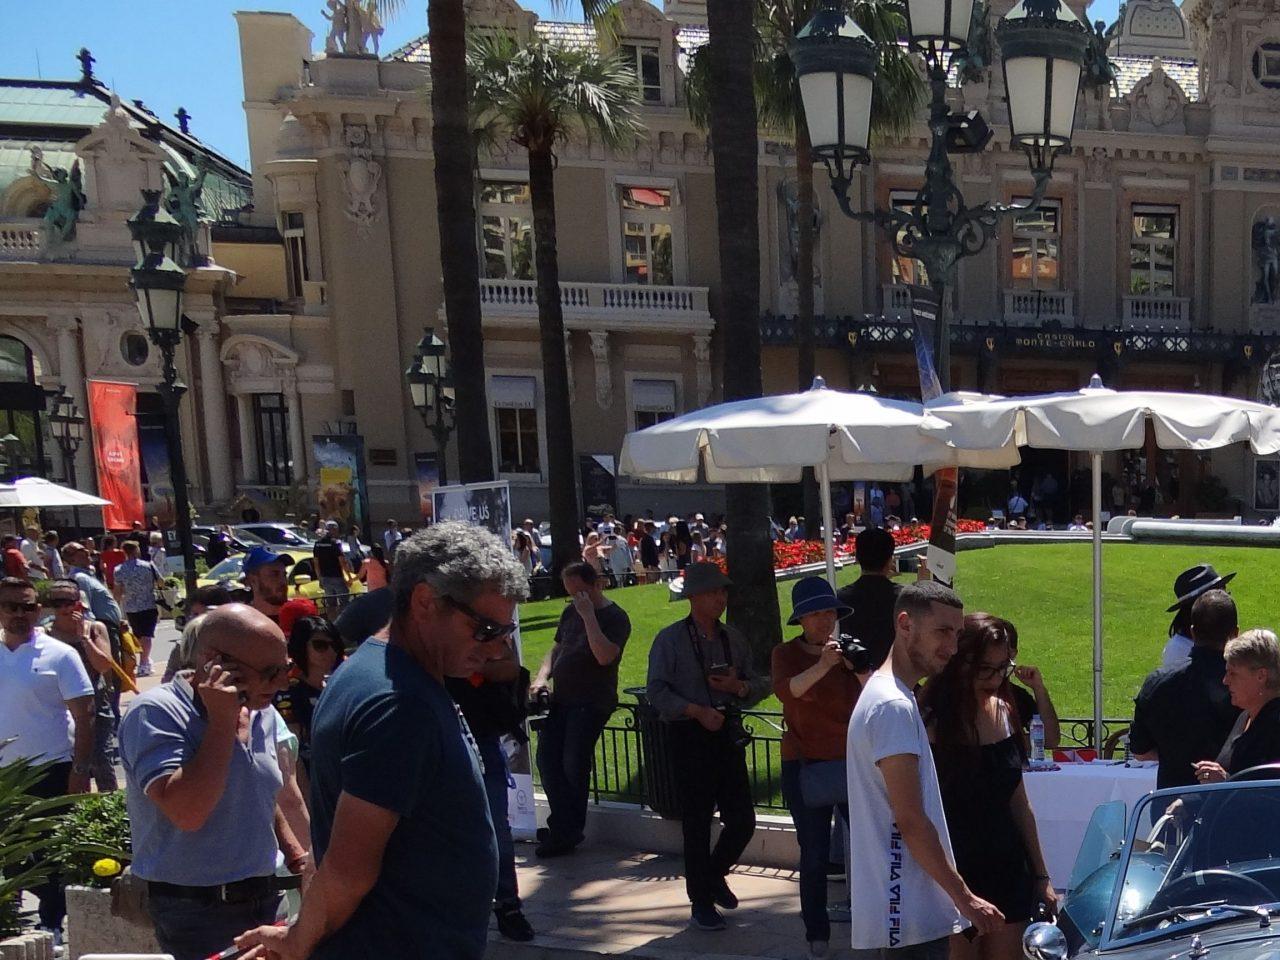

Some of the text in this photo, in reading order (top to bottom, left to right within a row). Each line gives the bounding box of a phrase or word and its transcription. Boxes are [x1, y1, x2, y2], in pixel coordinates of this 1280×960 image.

[890, 852, 902, 881] FILA
[889, 884, 901, 915] FILA
[889, 917, 901, 947] FILA
